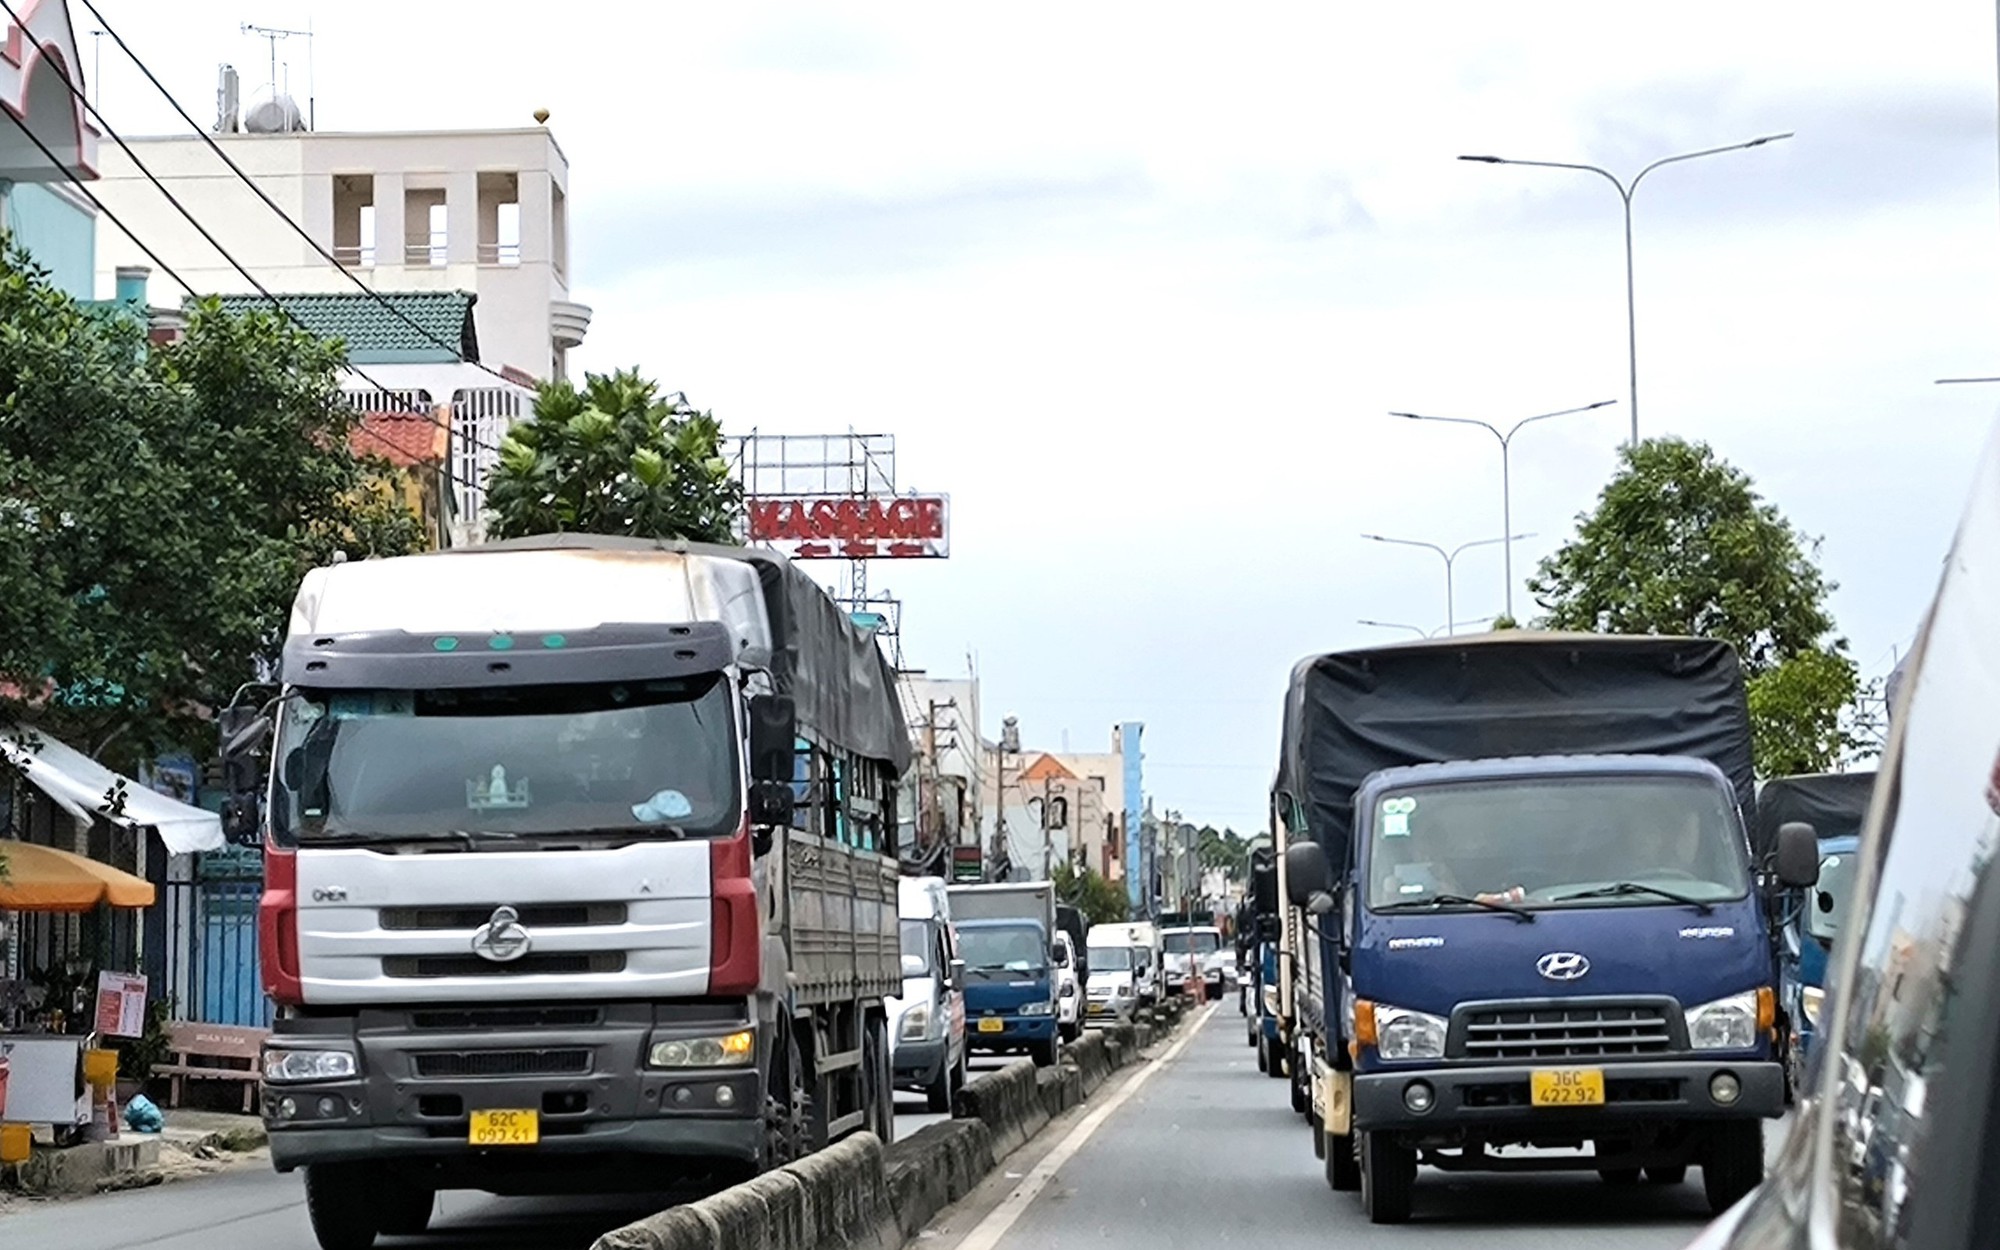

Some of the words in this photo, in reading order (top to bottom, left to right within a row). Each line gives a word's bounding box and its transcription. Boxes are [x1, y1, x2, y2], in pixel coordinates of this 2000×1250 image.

[749, 499, 942, 540] MASSAGE
[1551, 1071, 1582, 1086] 36C
[489, 1112, 518, 1126] 62C
